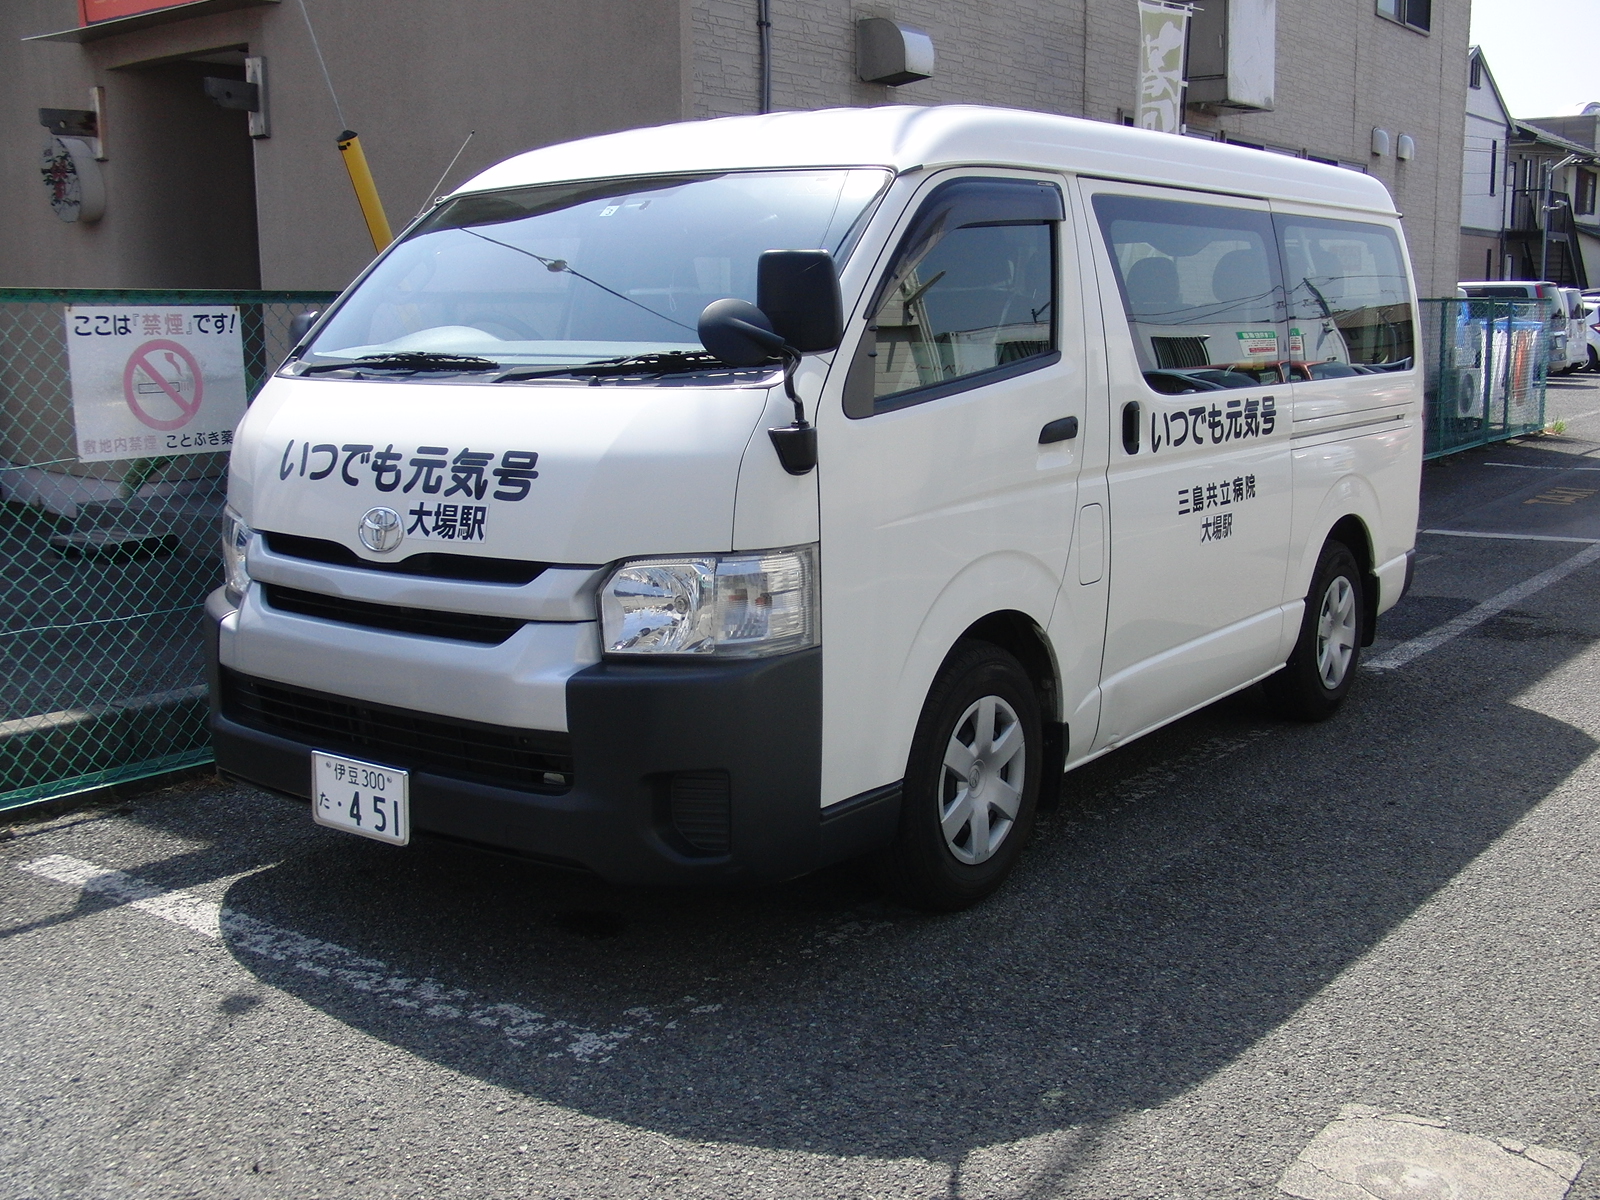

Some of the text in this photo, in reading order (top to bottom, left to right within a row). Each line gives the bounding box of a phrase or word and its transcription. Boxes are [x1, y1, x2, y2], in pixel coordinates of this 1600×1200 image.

[166, 430, 233, 449] ことぶき薬
[1151, 395, 1277, 453] いつでも元気号
[279, 439, 539, 502] いつでも元気号
[1178, 474, 1256, 515] 三島共立病院
[407, 502, 487, 541] 大場駅
[1201, 513, 1233, 543] 大場駅
